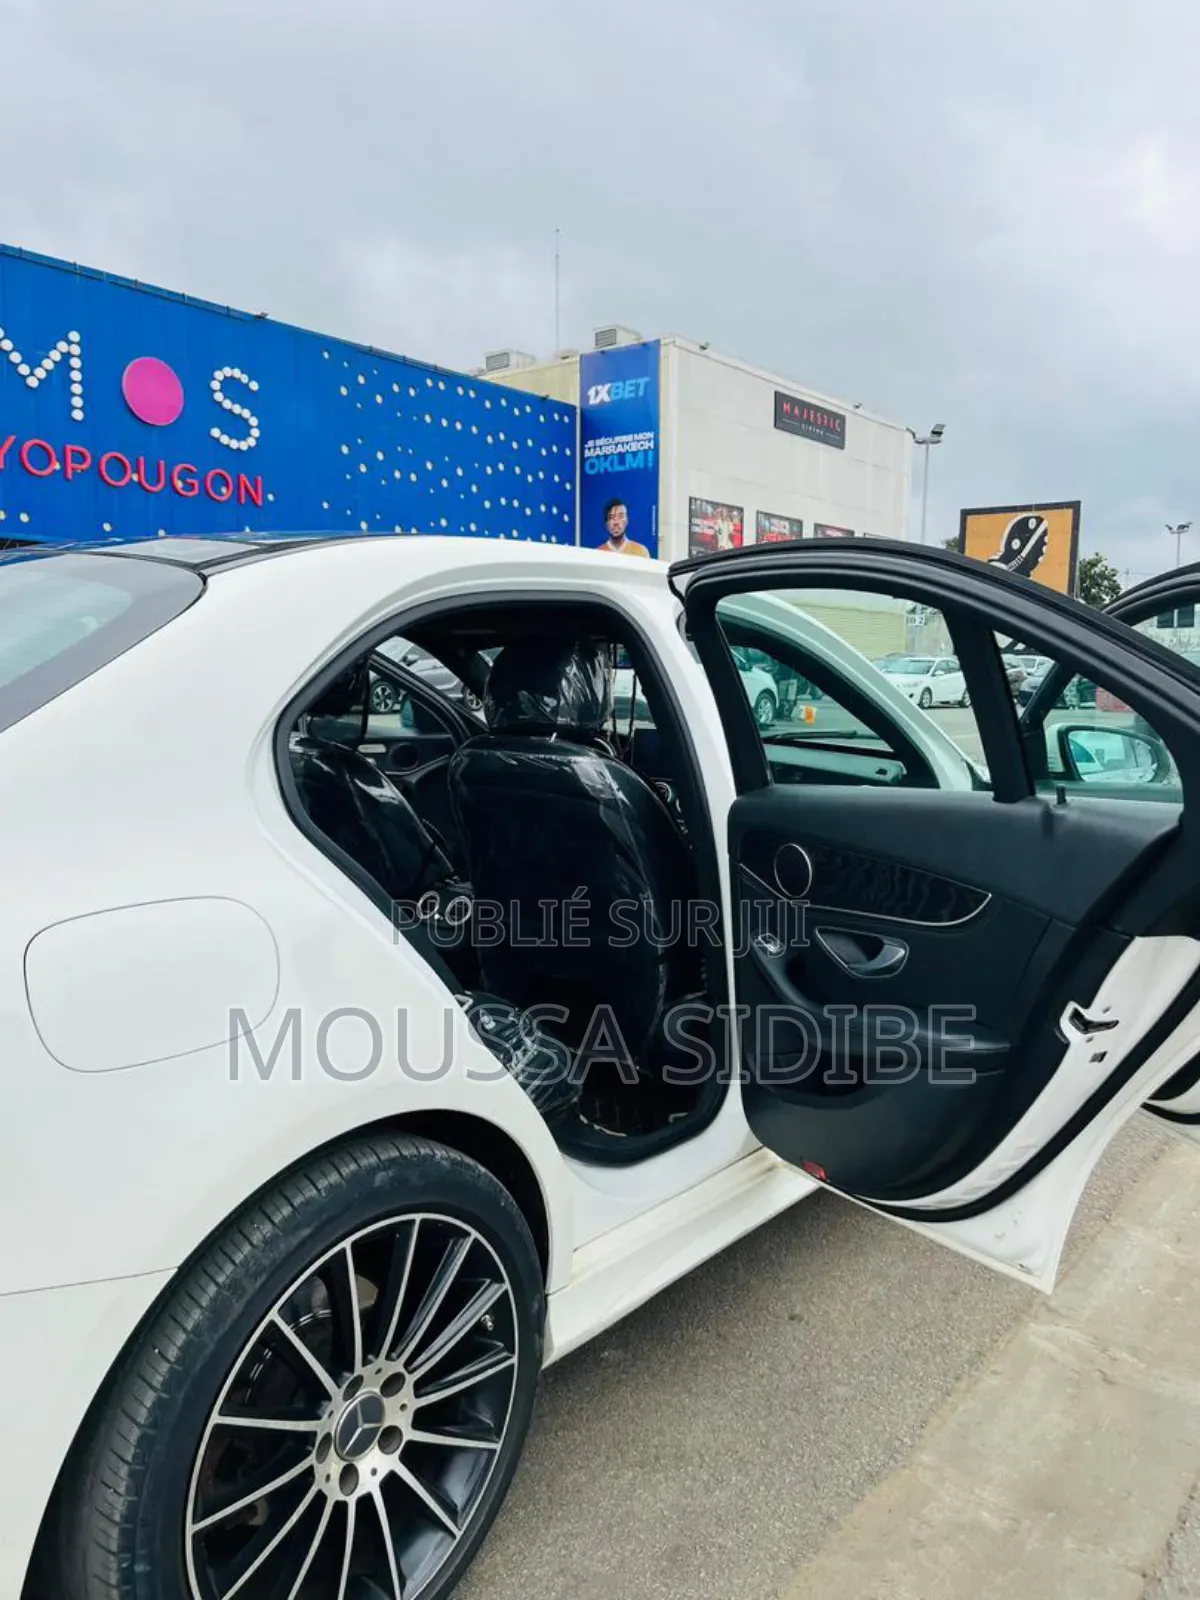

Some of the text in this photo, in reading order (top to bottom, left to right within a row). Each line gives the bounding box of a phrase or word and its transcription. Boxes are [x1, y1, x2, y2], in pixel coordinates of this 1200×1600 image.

[588, 376, 650, 405] 1XBET
[783, 402, 841, 432] MAJESTIC
[584, 440, 654, 458] MARRAKECH
[0, 435, 263, 506] YOPOUGON
